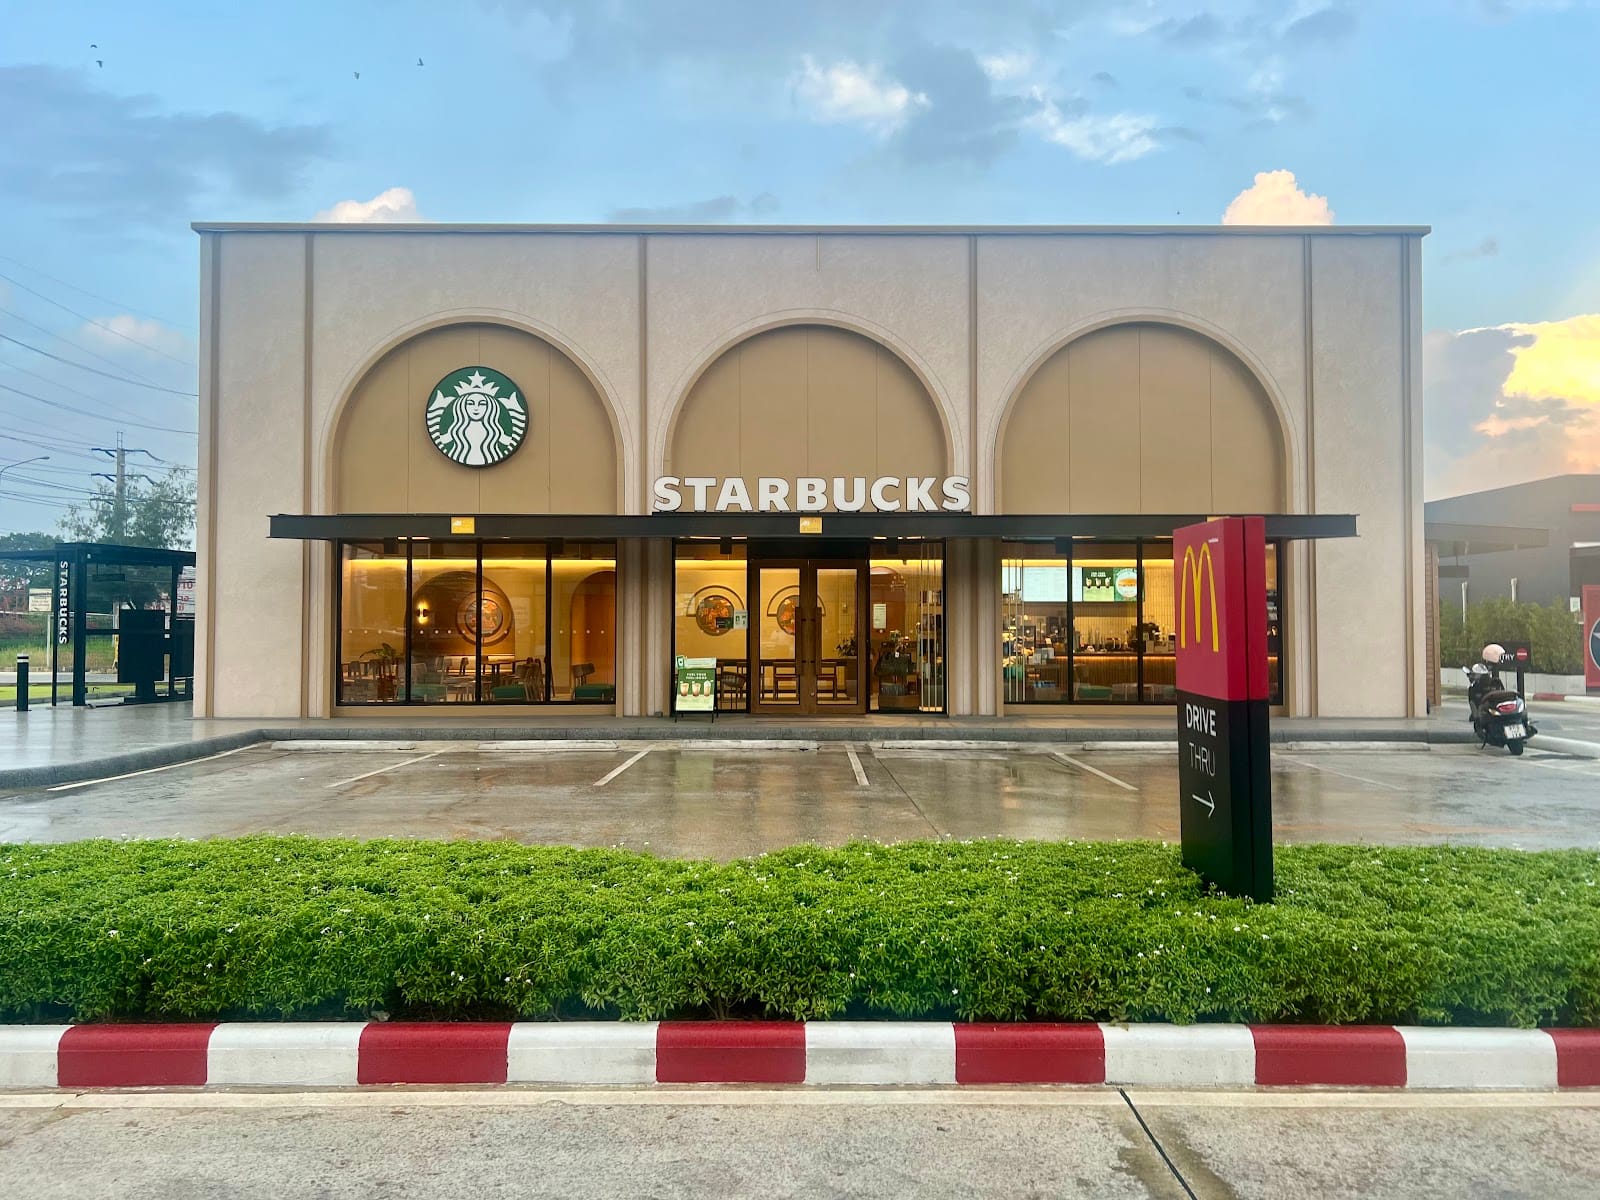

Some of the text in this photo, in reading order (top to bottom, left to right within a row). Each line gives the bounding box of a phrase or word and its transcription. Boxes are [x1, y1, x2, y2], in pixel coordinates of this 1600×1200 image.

[652, 476, 971, 512] STARBUCKS
[59, 561, 68, 644] STARBUCKS
[1186, 703, 1217, 737] DRIVE
[1189, 742, 1216, 776] THRU
